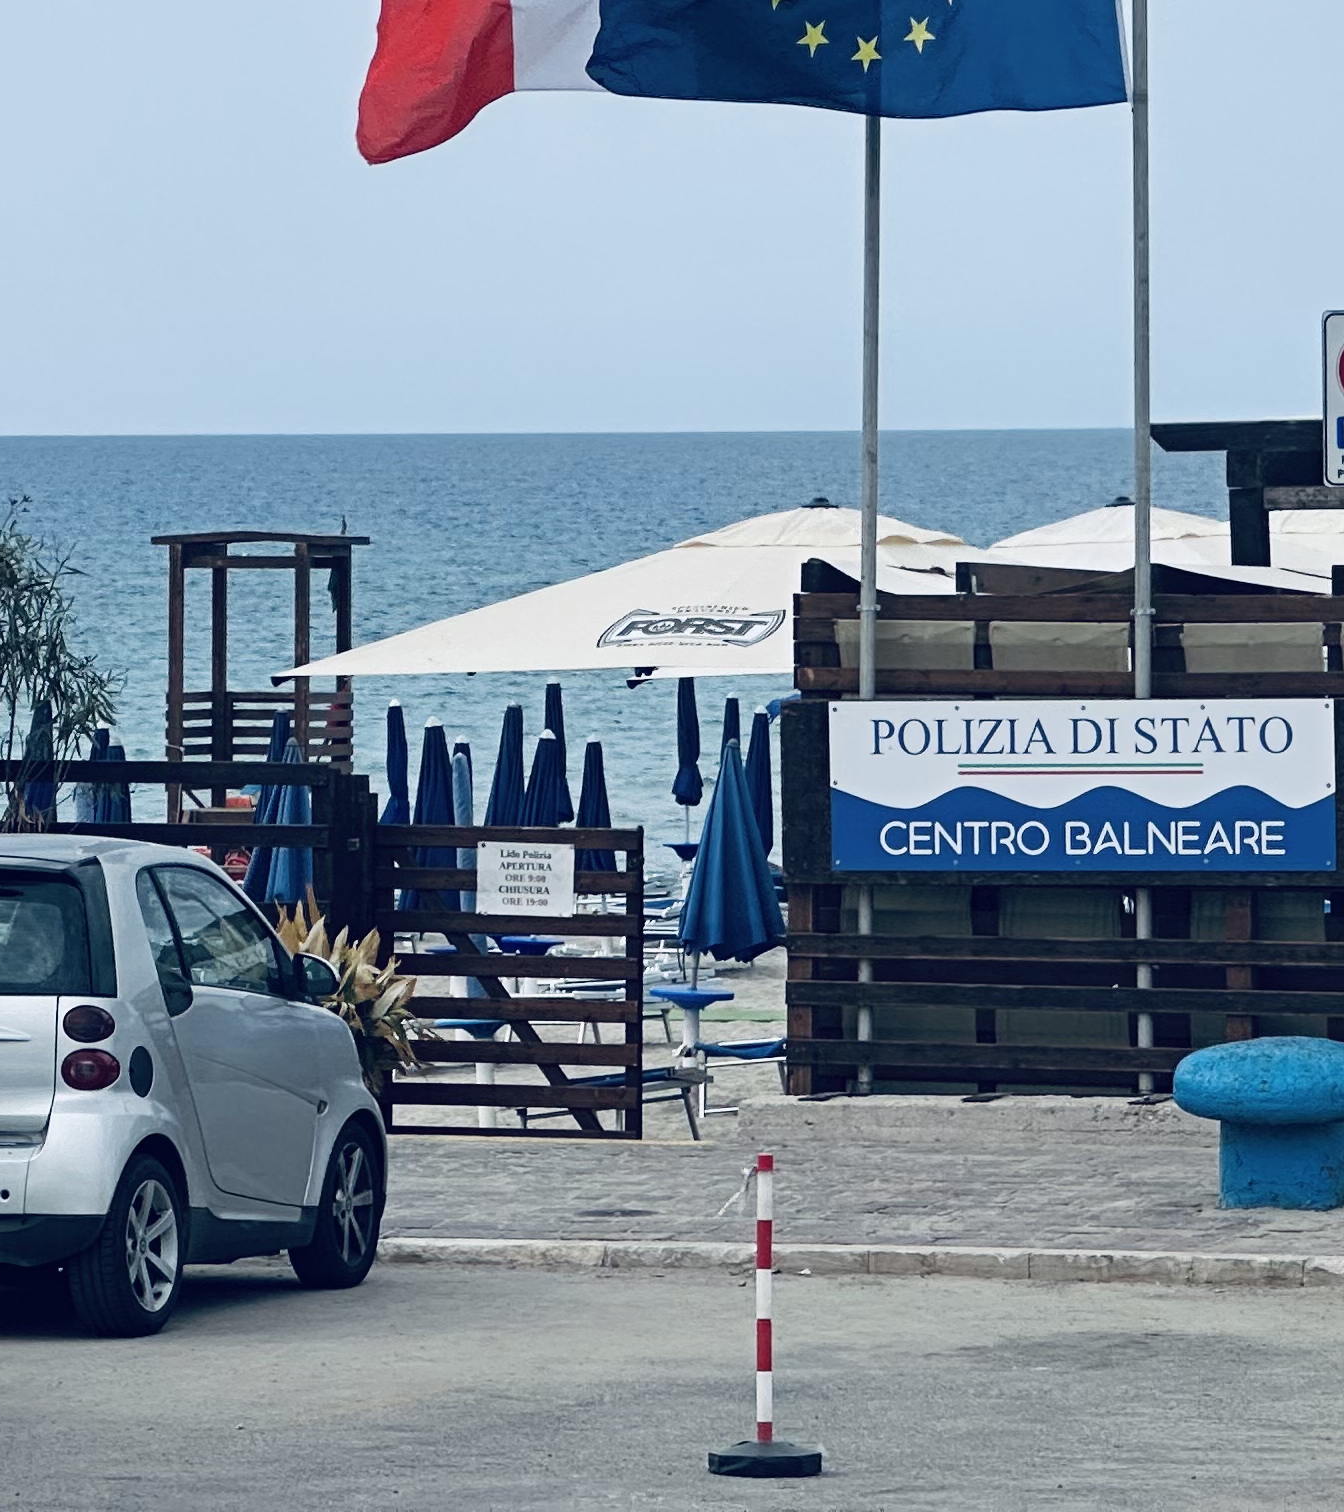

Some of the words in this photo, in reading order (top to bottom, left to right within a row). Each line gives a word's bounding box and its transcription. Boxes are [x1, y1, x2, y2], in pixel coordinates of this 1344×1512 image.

[616, 617, 771, 638] FORST
[870, 718, 1057, 756] POLIZIA
[1068, 718, 1120, 755] DI
[1134, 716, 1294, 755] STATO
[879, 820, 1051, 856] CENTRO
[1064, 820, 1287, 856] BALNEARE
[500, 849, 521, 859] Lido
[522, 850, 552, 860] Polizia
[499, 861, 552, 871] APERTURA
[505, 873, 526, 882] ORE
[498, 885, 550, 895] CHIUSURA
[502, 897, 523, 906] ORE
[526, 898, 548, 907] 19:00
